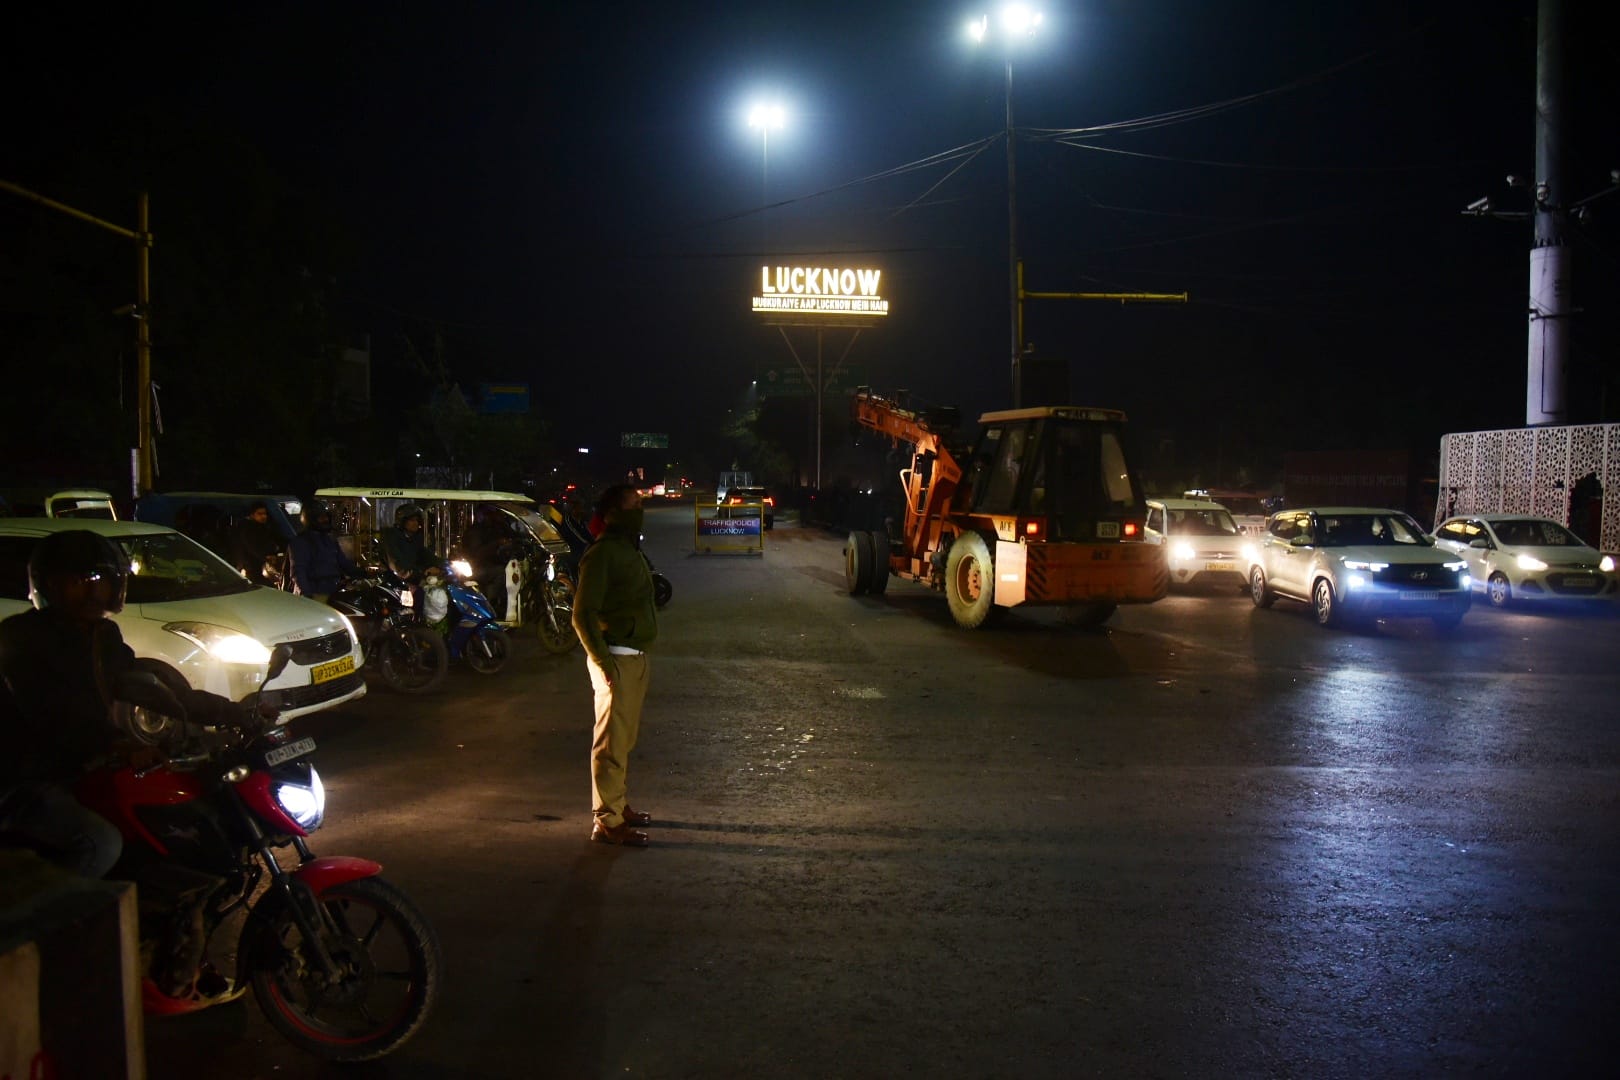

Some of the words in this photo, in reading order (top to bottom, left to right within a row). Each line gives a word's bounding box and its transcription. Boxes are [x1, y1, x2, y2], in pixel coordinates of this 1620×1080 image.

[762, 266, 881, 296] LUCKNOW
[752, 297, 799, 309] MUSKURAIYE
[800, 299, 816, 310] AAP
[817, 299, 851, 311] LUCKNOW
[704, 519, 731, 527] TRAFFIC
[732, 519, 756, 527] POLICE
